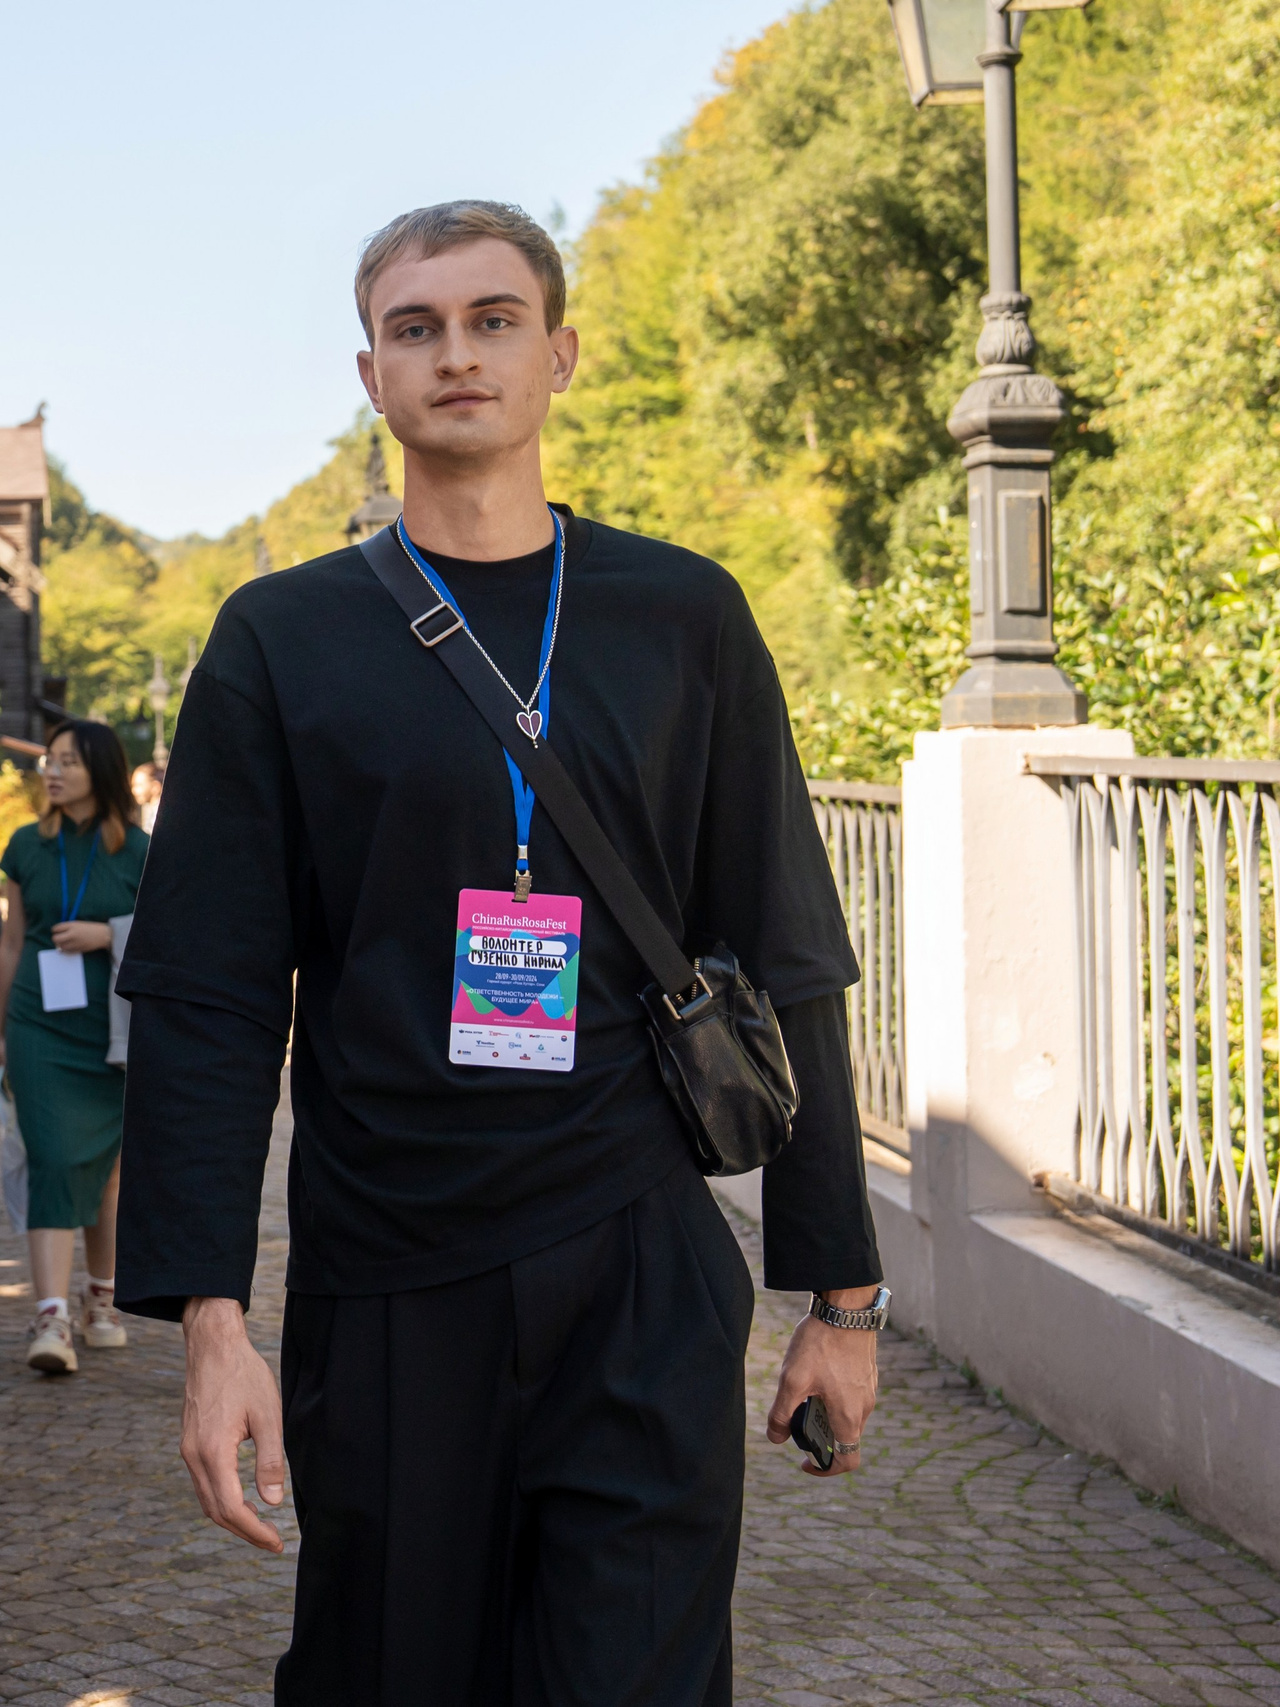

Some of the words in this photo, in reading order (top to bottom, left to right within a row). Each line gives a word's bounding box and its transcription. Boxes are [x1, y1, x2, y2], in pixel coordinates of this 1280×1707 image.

[472, 913, 566, 930] ChinaRusRosaFest
[482, 936, 542, 953] ВОЛОНТЕР
[470, 950, 518, 966] ГУЗЕНКО
